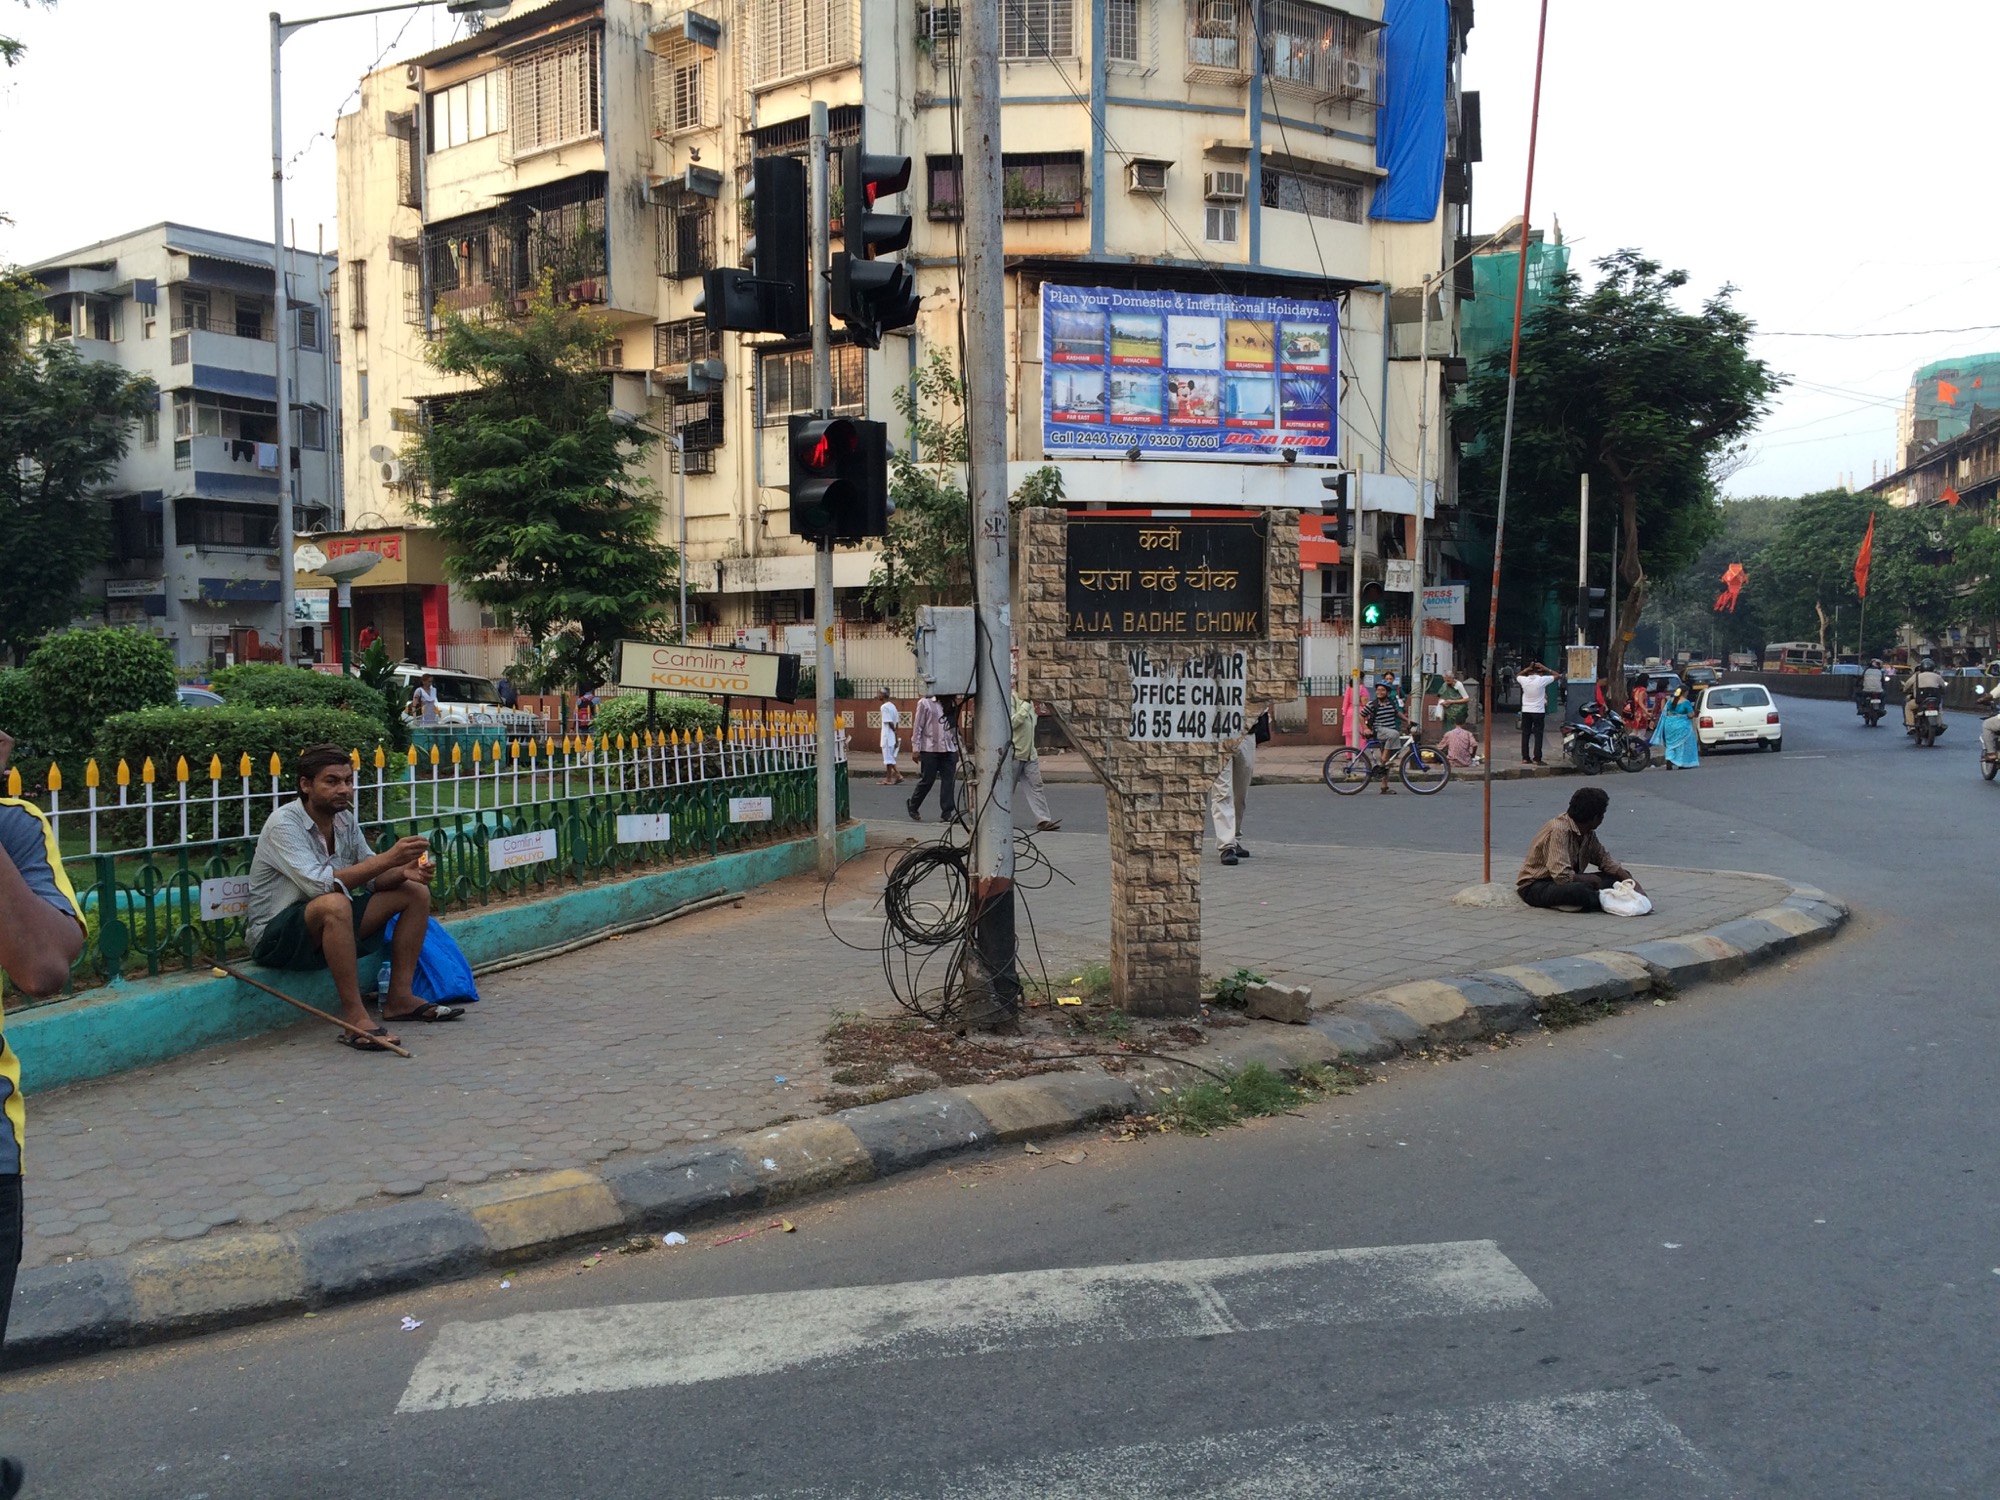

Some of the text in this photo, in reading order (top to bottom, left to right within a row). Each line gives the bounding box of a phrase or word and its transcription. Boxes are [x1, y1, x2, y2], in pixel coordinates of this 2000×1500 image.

[1049, 290, 1331, 318] Plan your Domestic & International Holidays...
[1122, 357, 1151, 365] HIMACHAL
[1235, 362, 1265, 370] RAJASTHAN
[1285, 421, 1312, 429] AUSTRALIA
[1051, 432, 1074, 443] Call
[1077, 432, 1107, 444] 2446
[1111, 433, 1137, 445] 7676
[1149, 435, 1183, 447] 93207
[1187, 436, 1219, 447] 67601
[1225, 433, 1330, 447] RAJA RANI
[1139, 526, 1182, 551] कवी
[1079, 569, 1132, 592] राजा
[1422, 590, 1453, 598] PRESS
[1426, 596, 1459, 605] MONEY
[1123, 611, 1187, 632] BADHE
[1195, 611, 1258, 632] CHOWK
[652, 649, 726, 670] Camlin
[1182, 652, 1243, 680] REPAIR
[652, 672, 749, 691] KOKUYO
[1191, 685, 1242, 706] CHAIR
[1177, 710, 1206, 738] 448
[1212, 711, 1241, 738] 449
[503, 835, 534, 851] Camlin
[504, 850, 544, 866] KOKUYO
